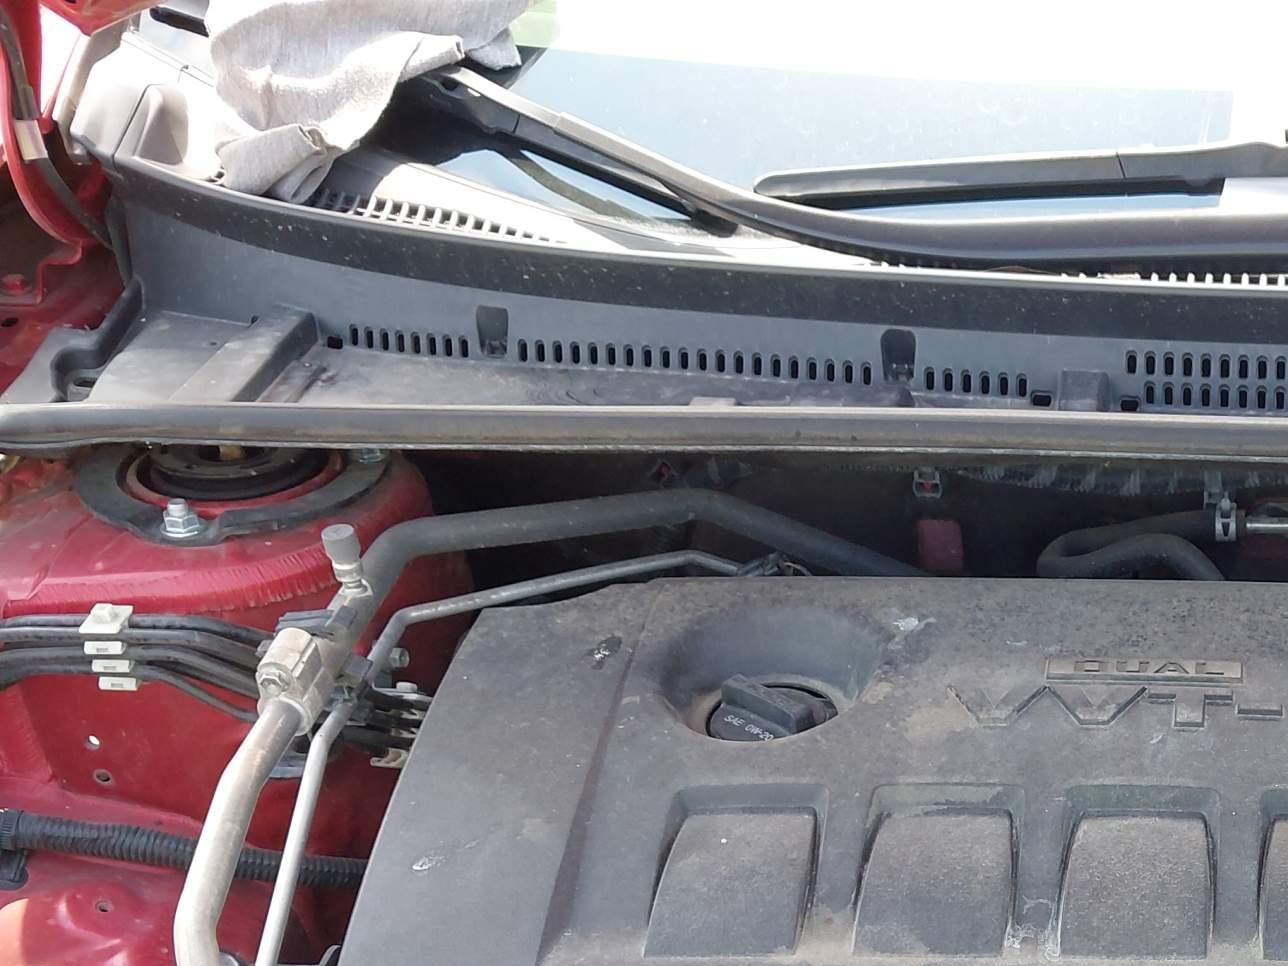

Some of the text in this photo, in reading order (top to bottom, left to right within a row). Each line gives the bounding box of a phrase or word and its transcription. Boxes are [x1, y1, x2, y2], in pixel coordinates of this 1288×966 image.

[1073, 659, 1225, 675] DUAL
[723, 714, 775, 741] SAE 0W-20
